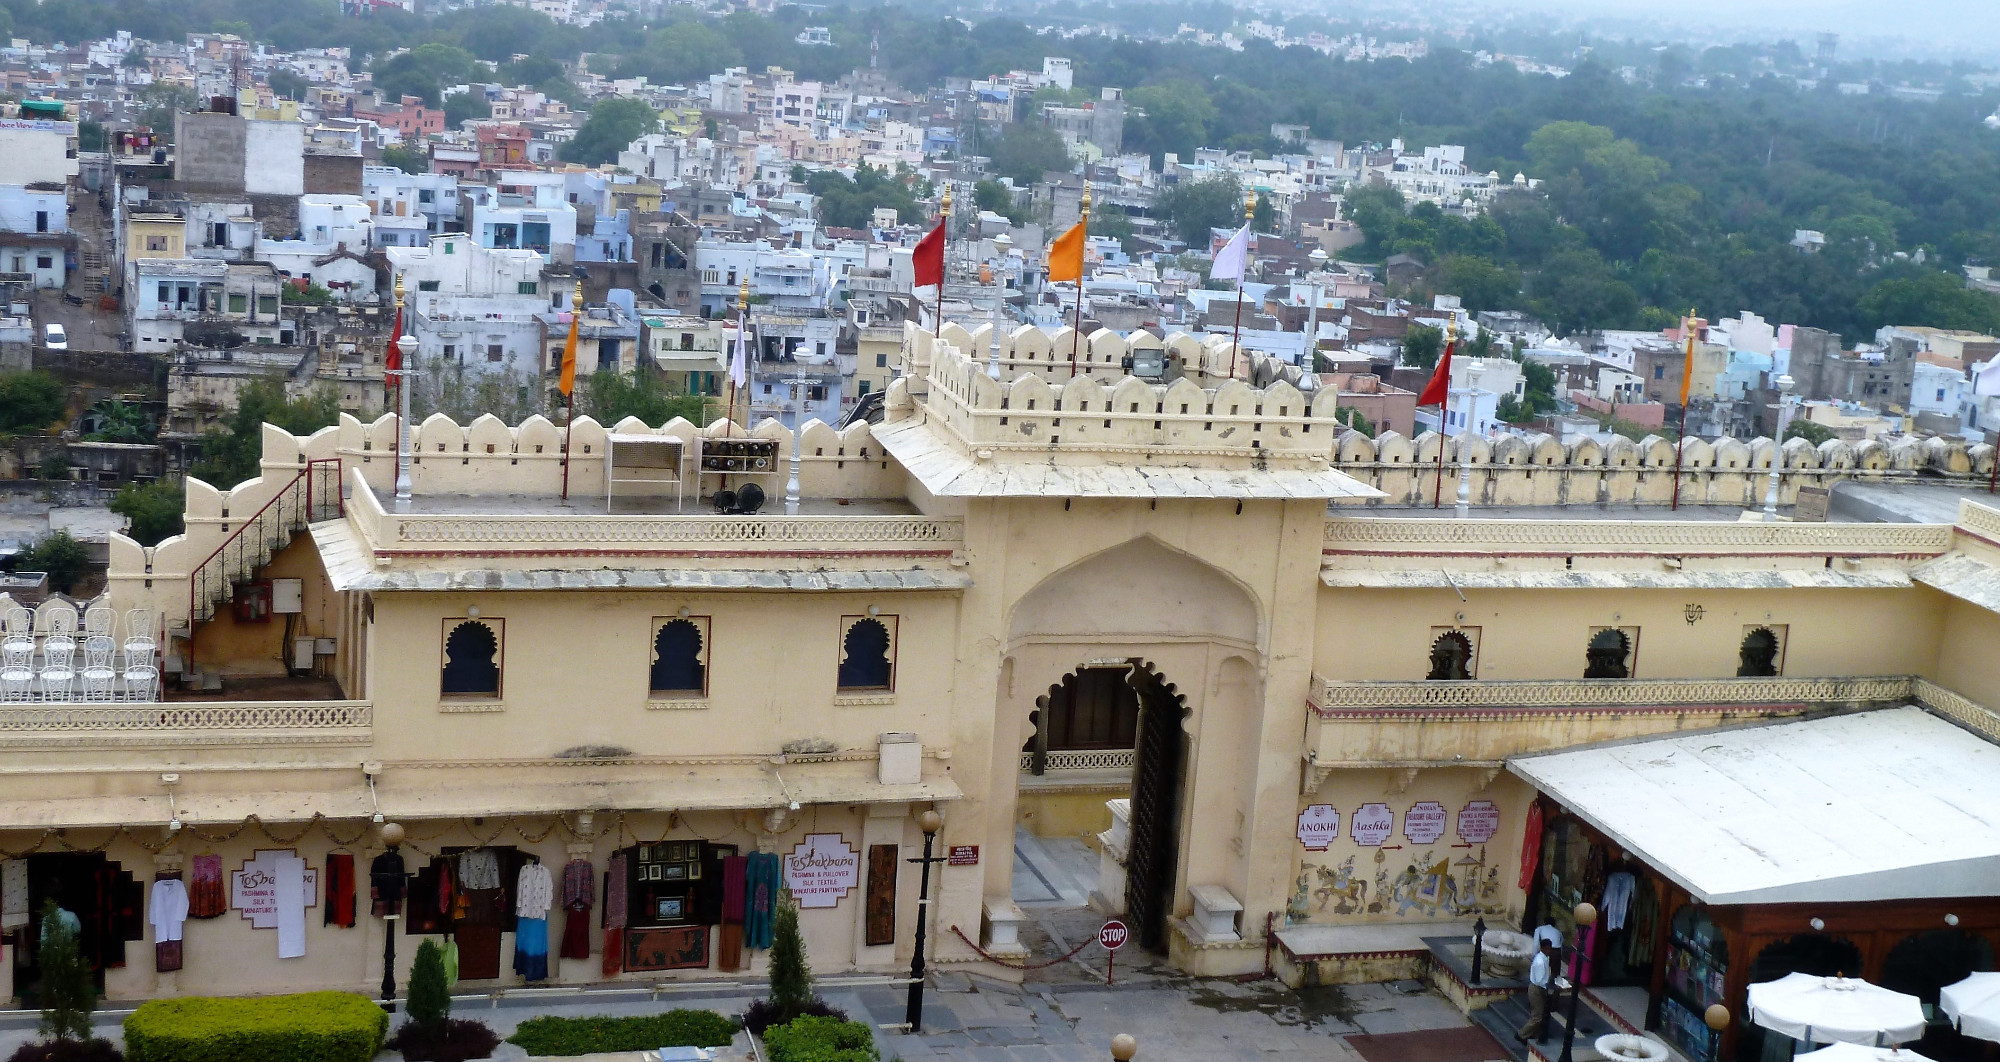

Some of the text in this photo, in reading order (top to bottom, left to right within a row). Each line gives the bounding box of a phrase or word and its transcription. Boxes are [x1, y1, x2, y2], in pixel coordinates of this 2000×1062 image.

[16, 121, 33, 129] View
[1300, 822, 1336, 832] ANOKHI
[1354, 820, 1390, 831] Aashka
[1102, 928, 1125, 942] STOP
